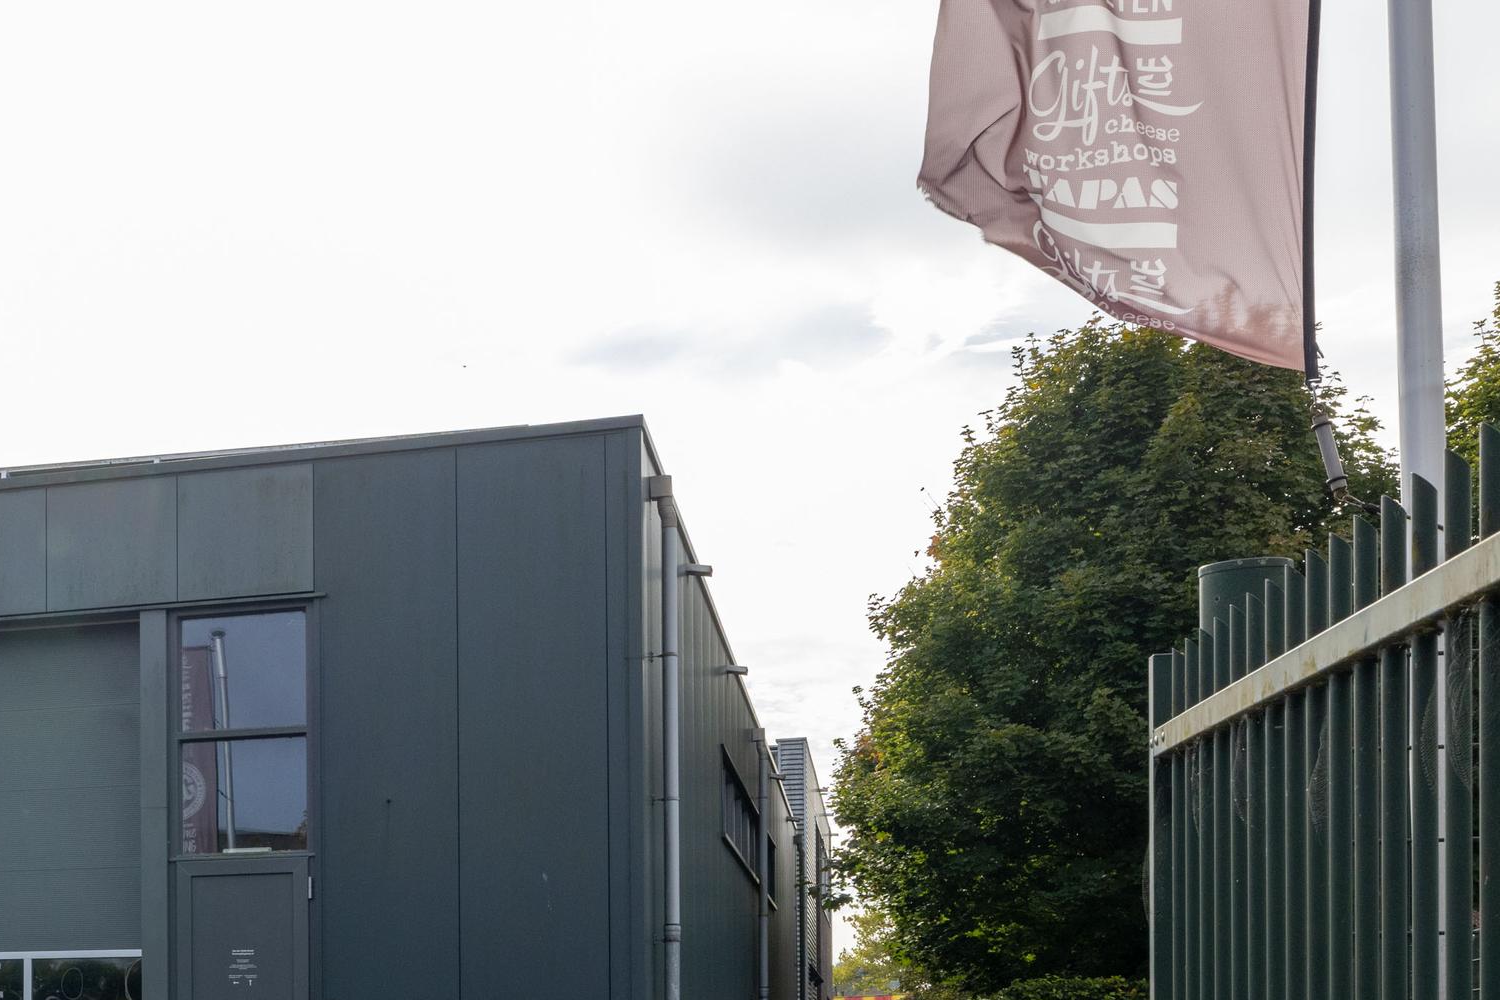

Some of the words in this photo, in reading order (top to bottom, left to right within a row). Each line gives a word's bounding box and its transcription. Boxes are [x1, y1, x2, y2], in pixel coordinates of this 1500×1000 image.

[1028, 45, 1205, 146] Gifts
[1136, 55, 1174, 97] ICE
[1104, 113, 1181, 142] cheese
[1025, 140, 1178, 171] workshops
[1022, 164, 1179, 210] TAPAS
